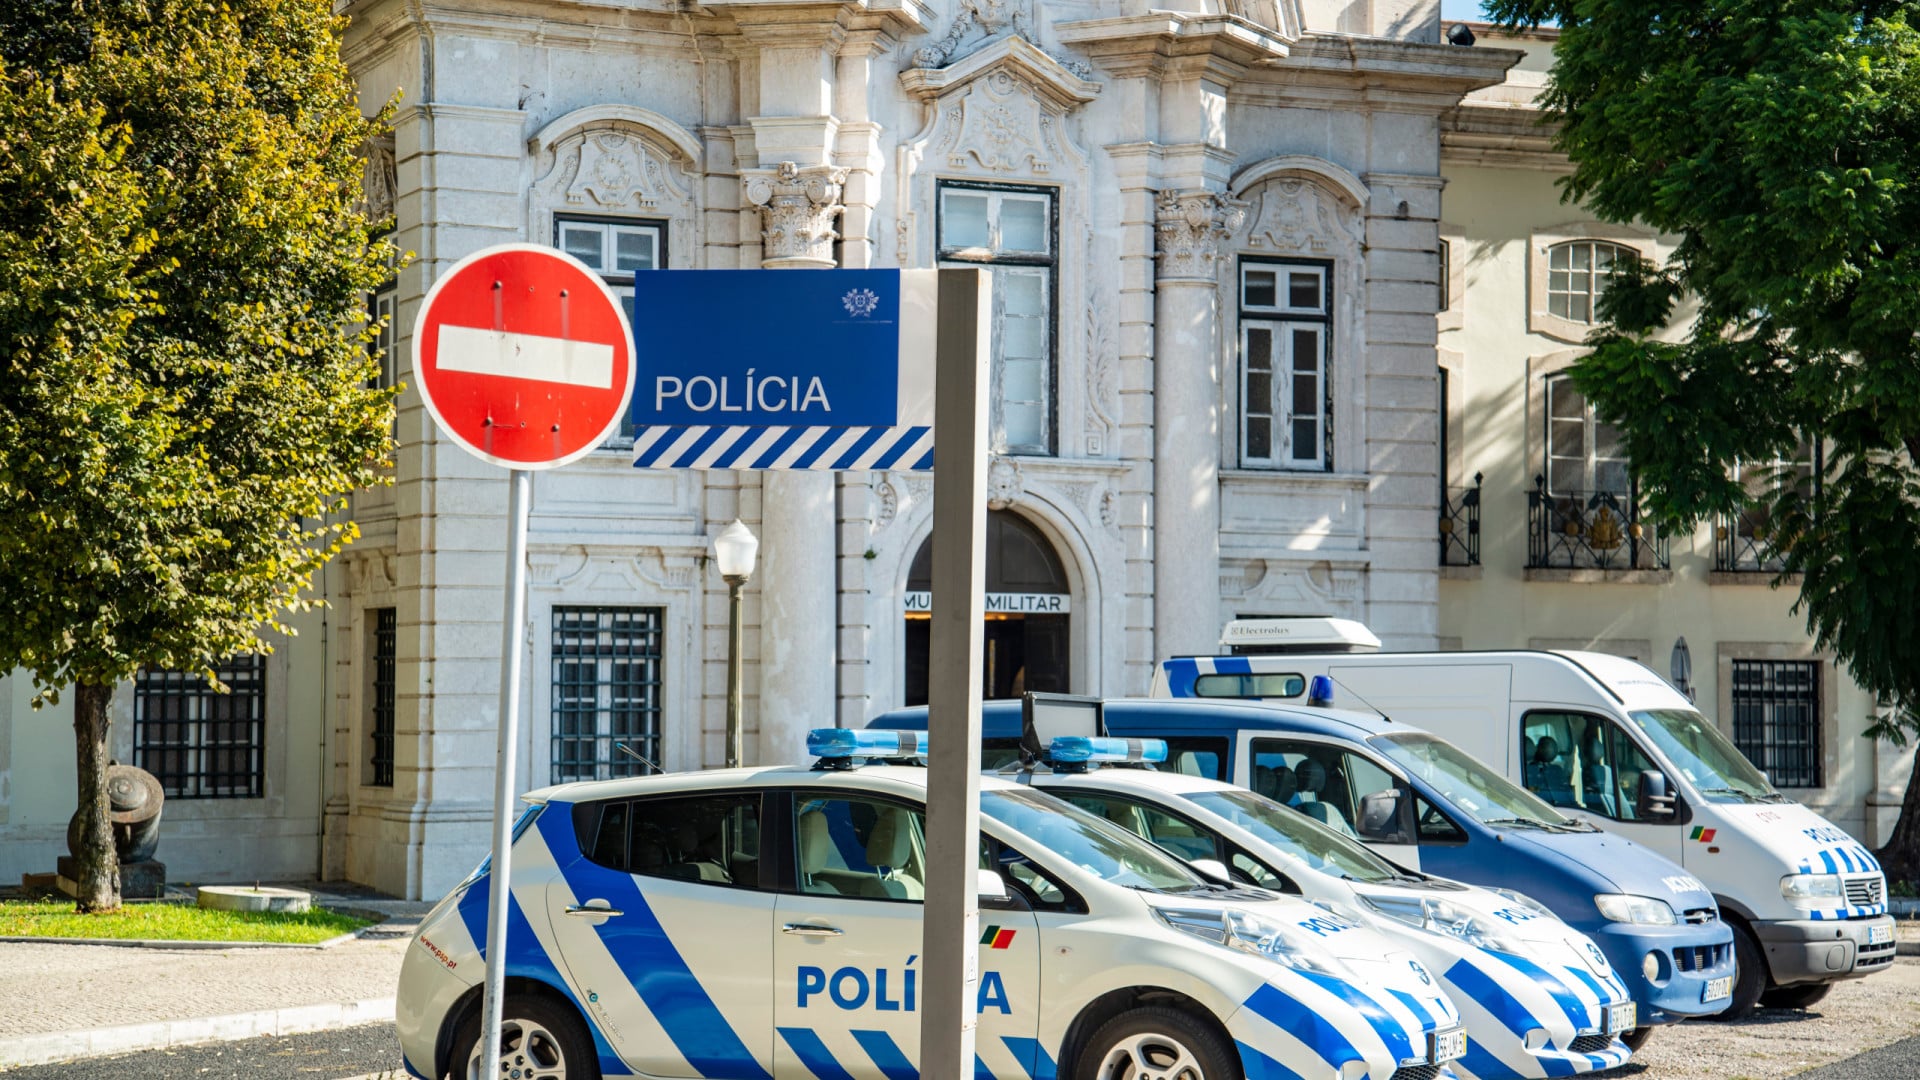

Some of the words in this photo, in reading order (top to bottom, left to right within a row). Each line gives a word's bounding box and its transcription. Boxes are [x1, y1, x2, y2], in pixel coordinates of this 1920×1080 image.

[655, 367, 832, 412] POLÍCIA
[986, 595, 1062, 611] MILITAR
[1239, 626, 1290, 636] Electrolux
[797, 954, 1013, 1015] POLÍA
